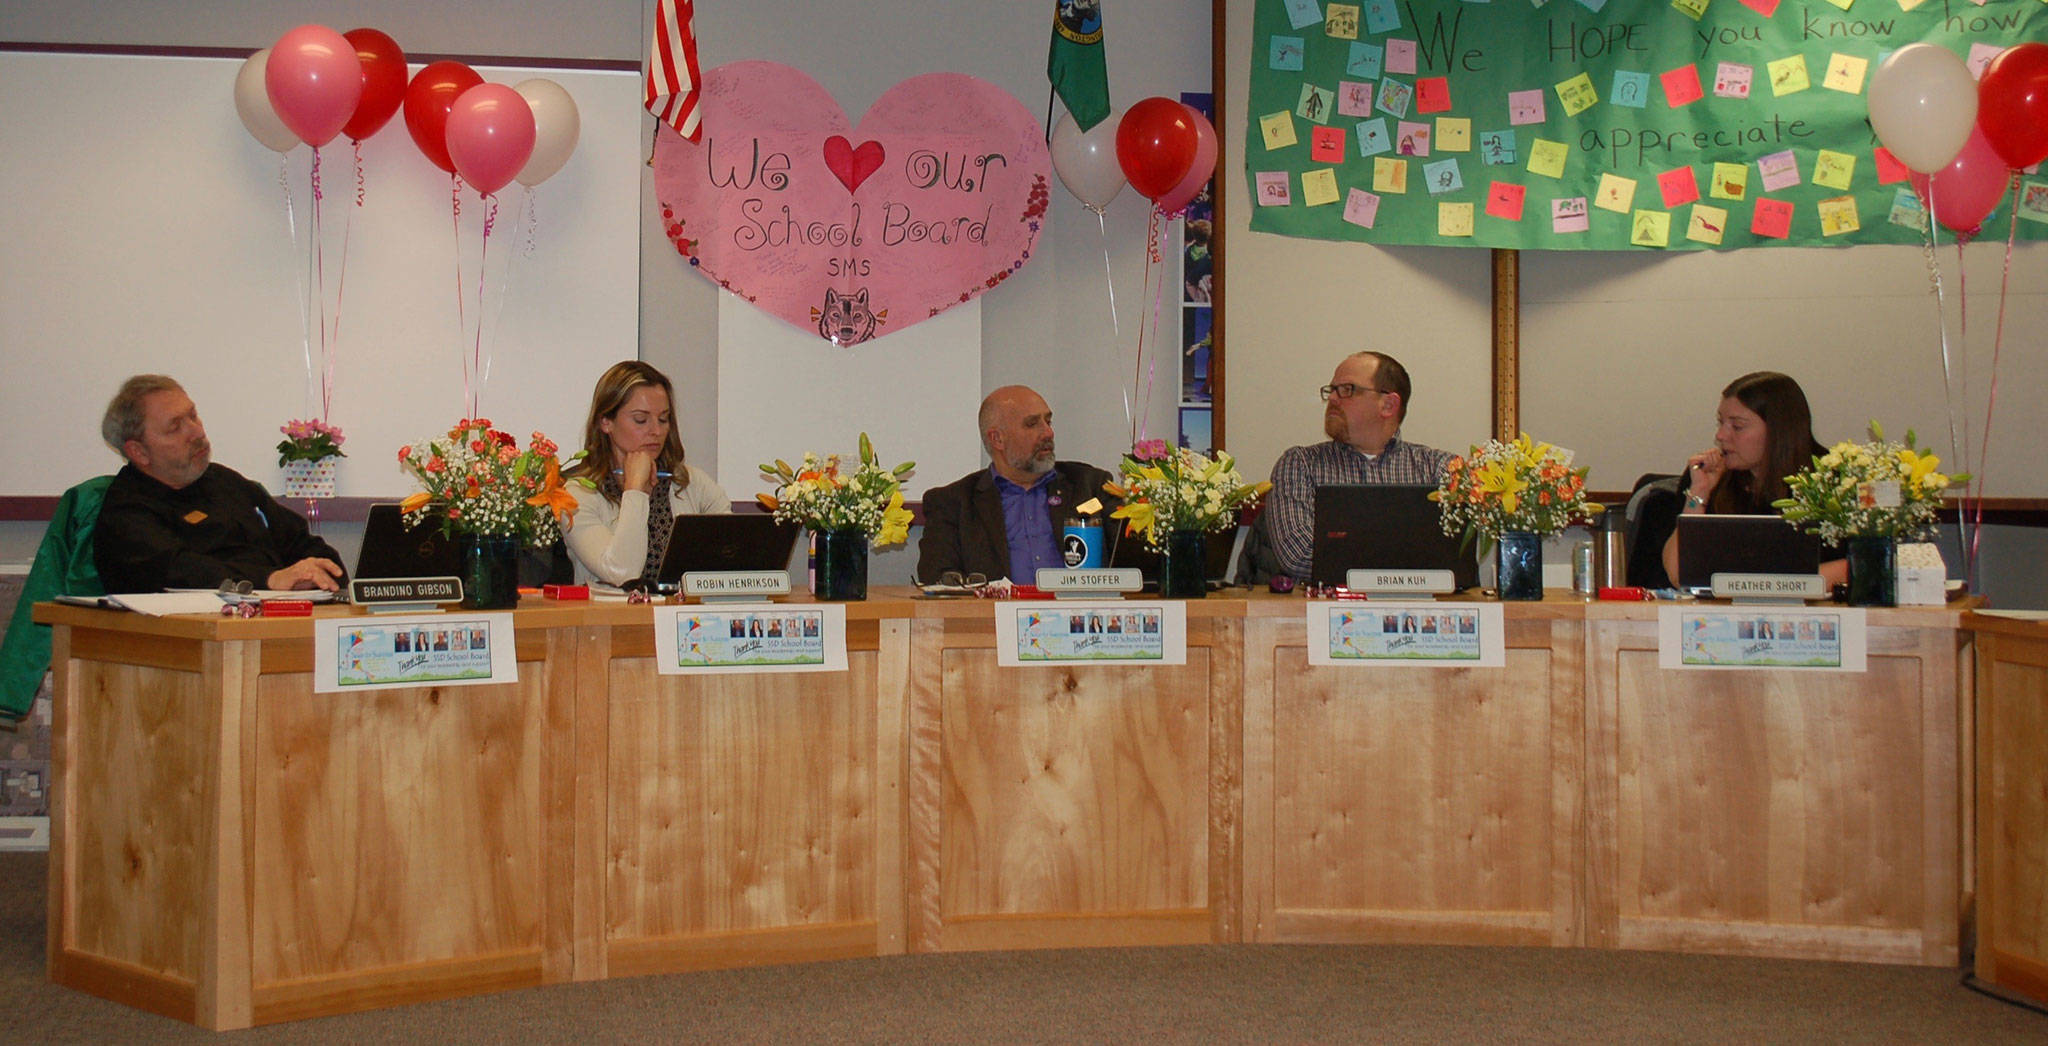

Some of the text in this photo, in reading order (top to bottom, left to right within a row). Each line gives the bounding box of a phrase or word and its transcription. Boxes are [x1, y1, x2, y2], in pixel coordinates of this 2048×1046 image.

[1406, 0, 2022, 73] We HOPE you know how
[1580, 113, 1815, 168] appreciate
[708, 137, 791, 190] We
[734, 199, 993, 251] School Board
[827, 258, 871, 277] SMS
[697, 578, 780, 589] ROBIN HENRIKSON
[1060, 575, 1120, 585] JIM STOFFER
[1377, 576, 1426, 585] BRIAN KUH
[1728, 581, 1807, 591] HEATHER SHORT
[364, 584, 452, 597] BRANDINO GIBSON
[447, 653, 470, 661] School
